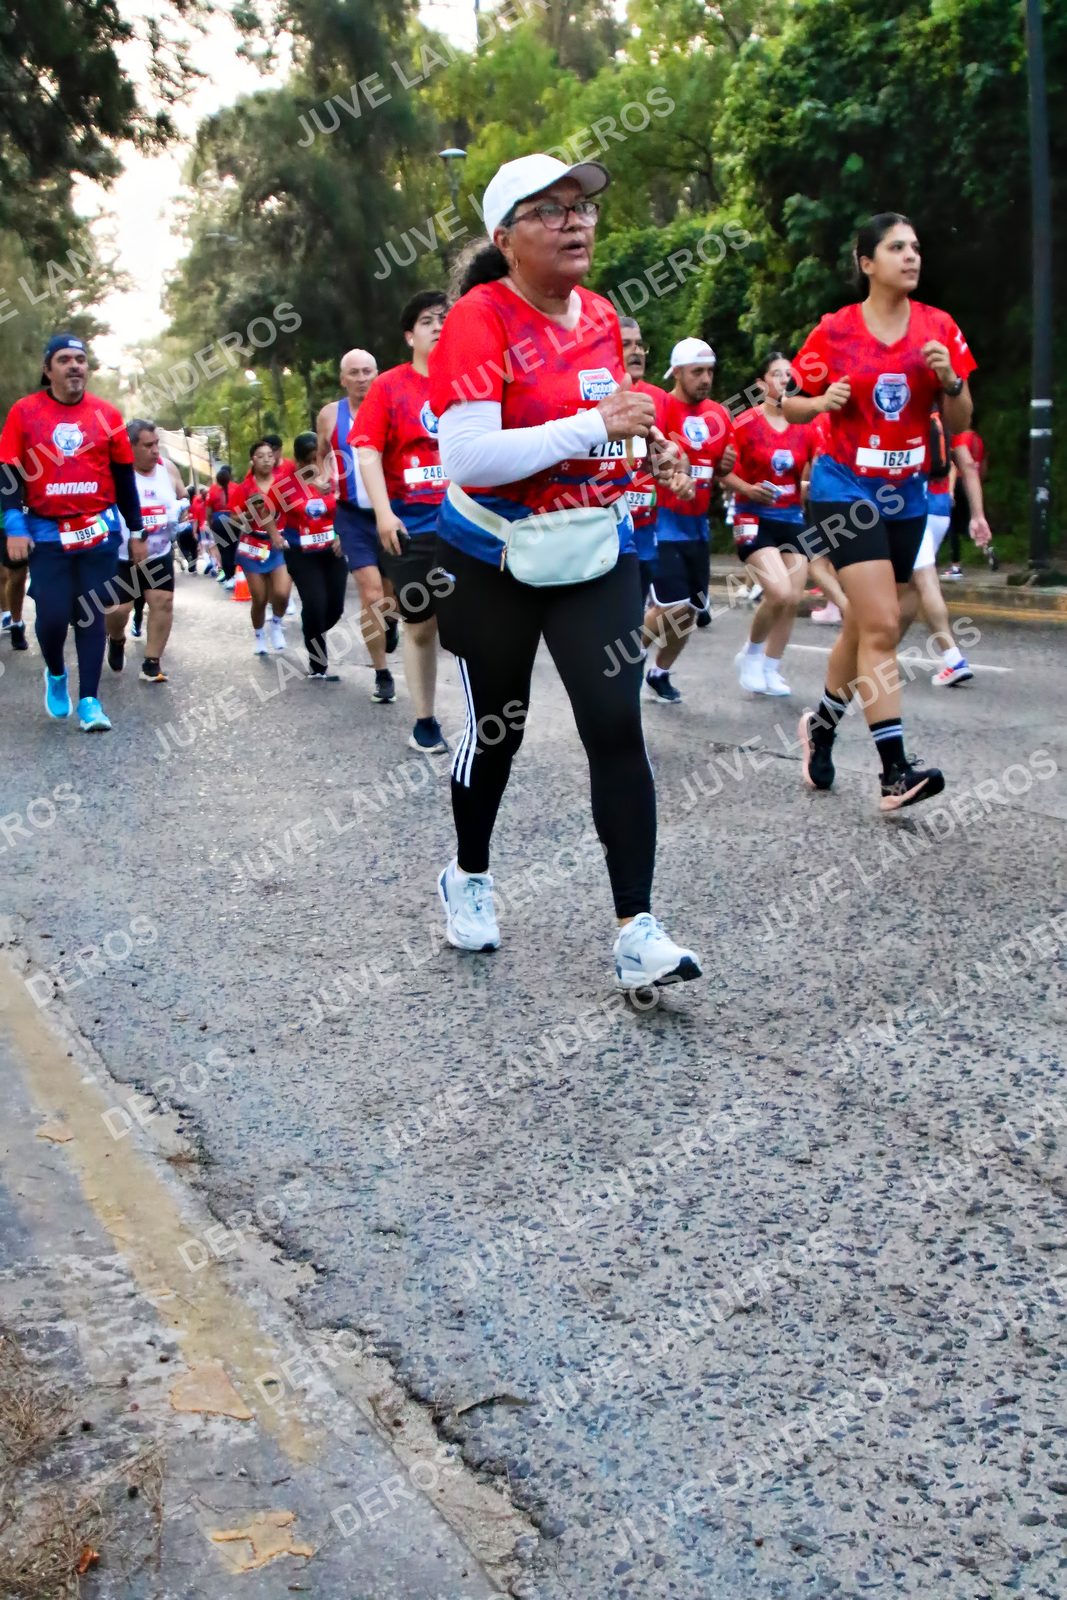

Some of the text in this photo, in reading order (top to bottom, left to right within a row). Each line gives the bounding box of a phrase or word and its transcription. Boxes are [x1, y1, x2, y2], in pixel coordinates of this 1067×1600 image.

[883, 451, 911, 467] 1624
[46, 481, 99, 496] SANTIAGO
[75, 526, 96, 541] 1394
